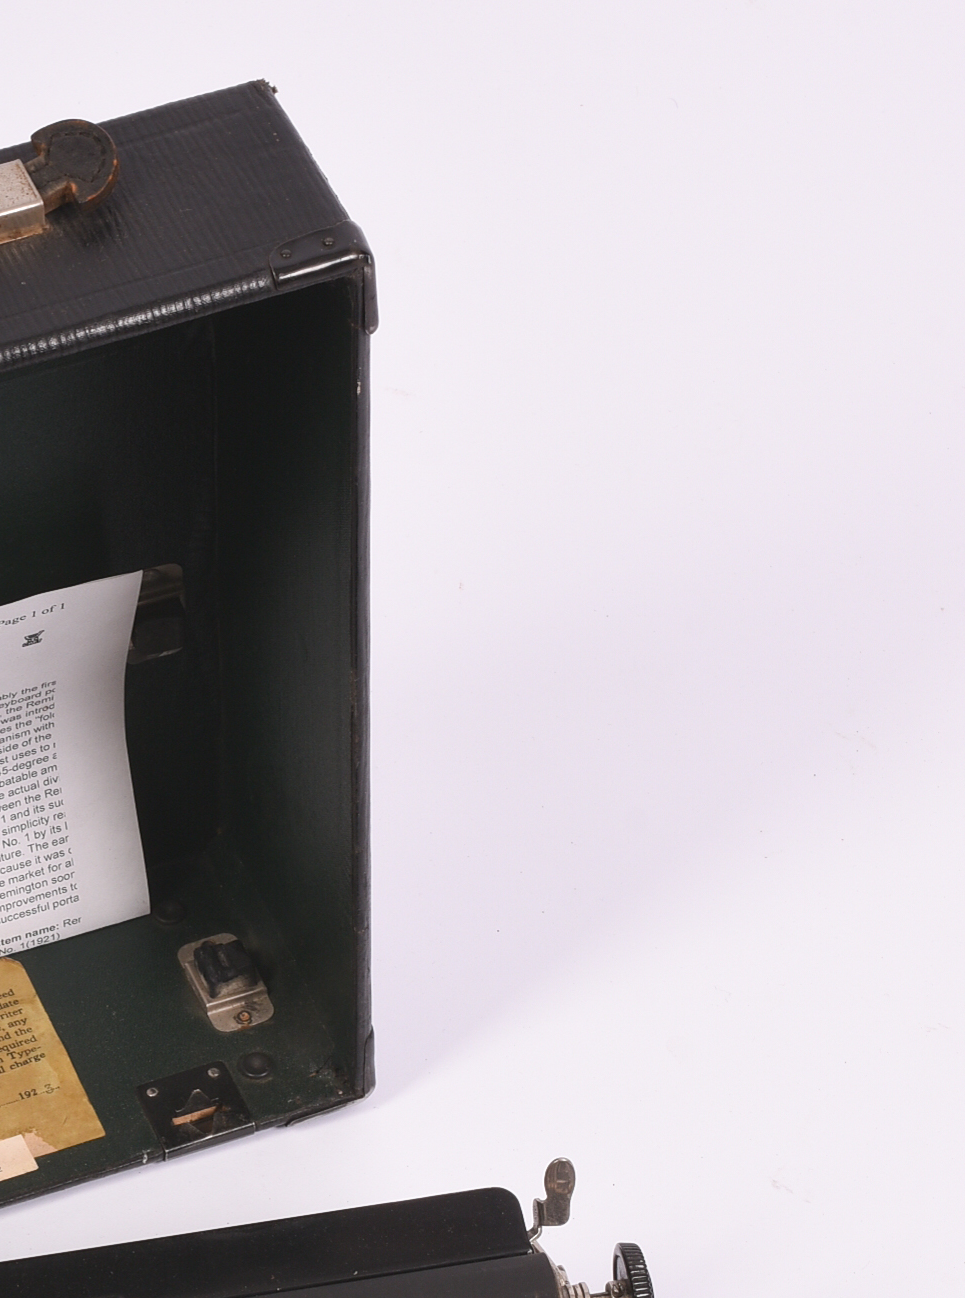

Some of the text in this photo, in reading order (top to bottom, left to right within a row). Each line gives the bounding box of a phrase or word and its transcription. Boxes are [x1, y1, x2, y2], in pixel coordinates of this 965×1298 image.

[31, 610, 37, 618] 1
[41, 604, 57, 614] of
[59, 602, 66, 610] 1
[21, 686, 38, 694] the
[33, 722, 55, 733] with
[21, 737, 32, 747] of
[34, 733, 52, 743] the
[24, 793, 41, 804] the
[1, 816, 50, 836] simplicity
[27, 841, 49, 853] The
[8, 867, 45, 884] market
[48, 863, 62, 873] for
[25, 924, 59, 938] name:
